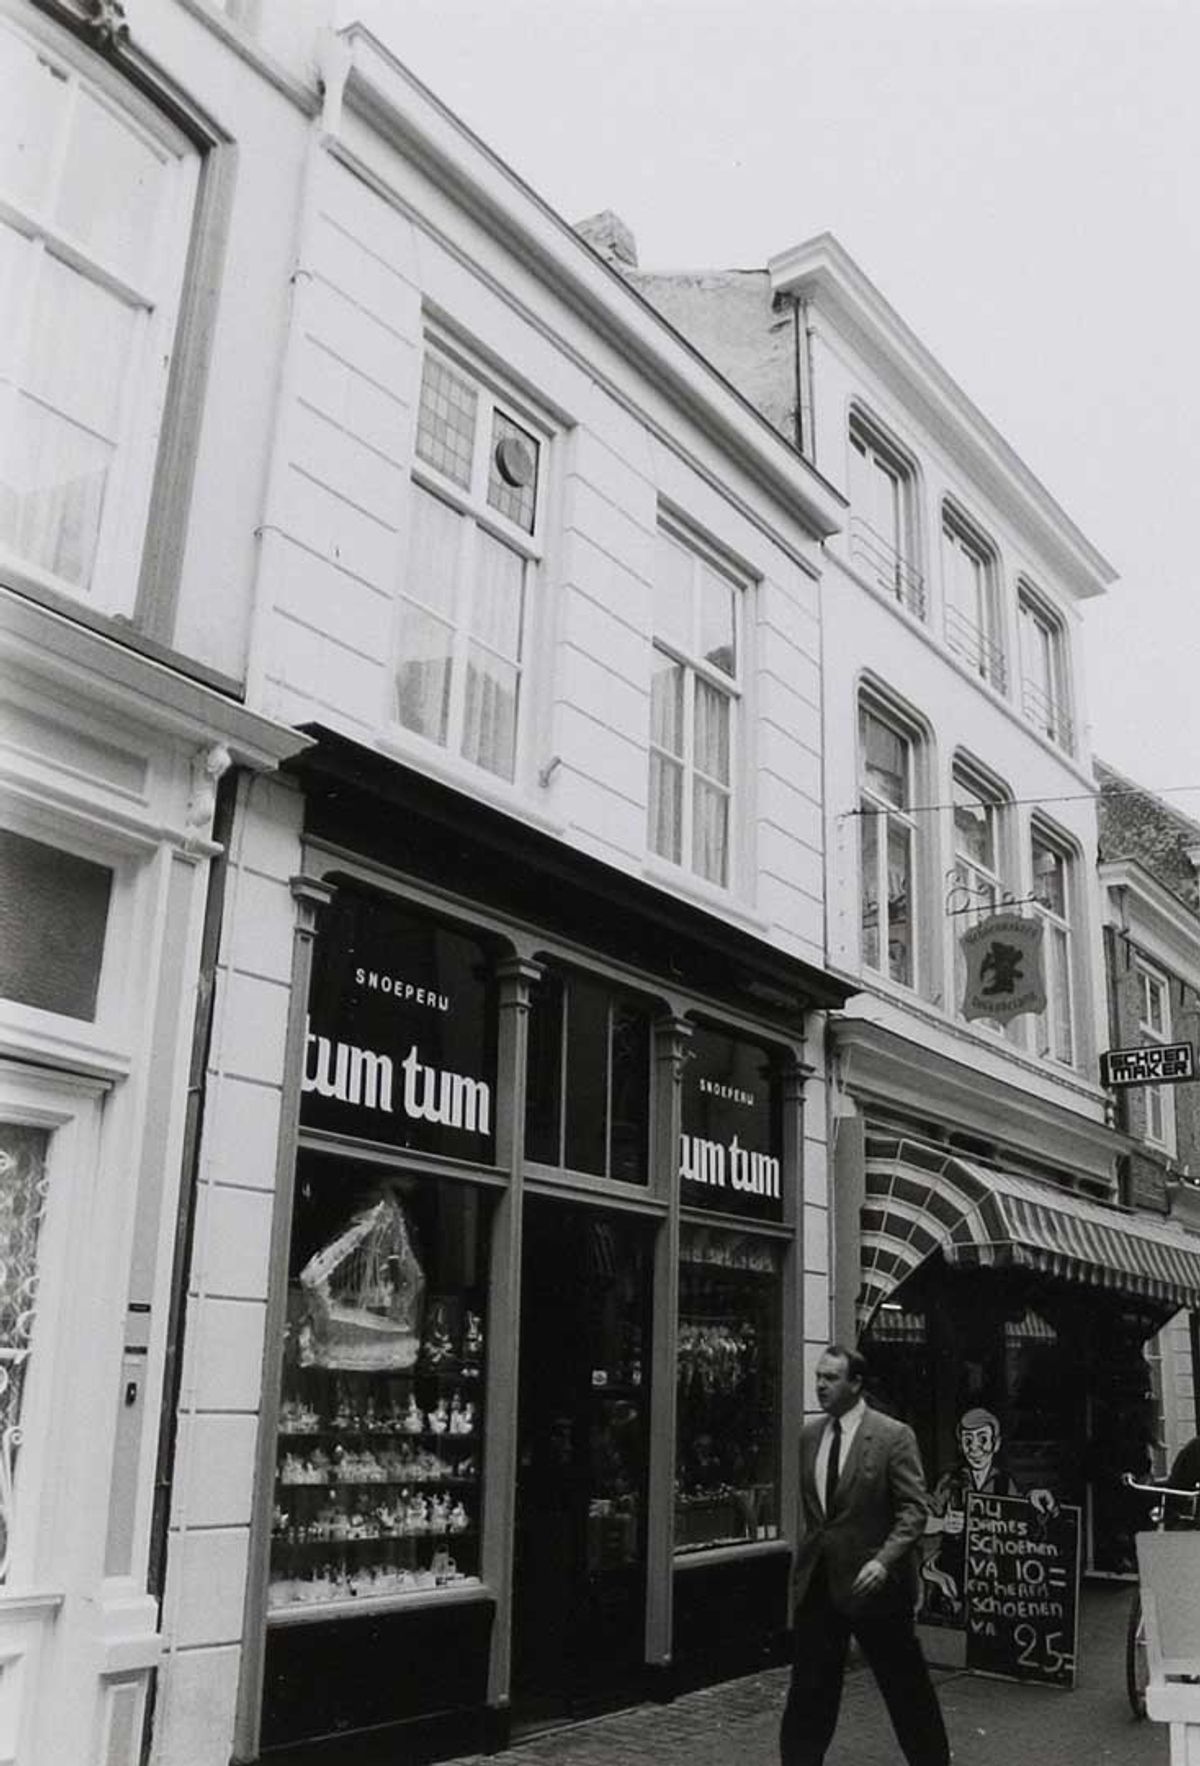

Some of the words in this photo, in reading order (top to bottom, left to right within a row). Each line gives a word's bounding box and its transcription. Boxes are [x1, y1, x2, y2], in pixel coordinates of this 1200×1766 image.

[402, 1045, 490, 1135] tum
[679, 1133, 726, 1187] um
[728, 1134, 780, 1199] tum
